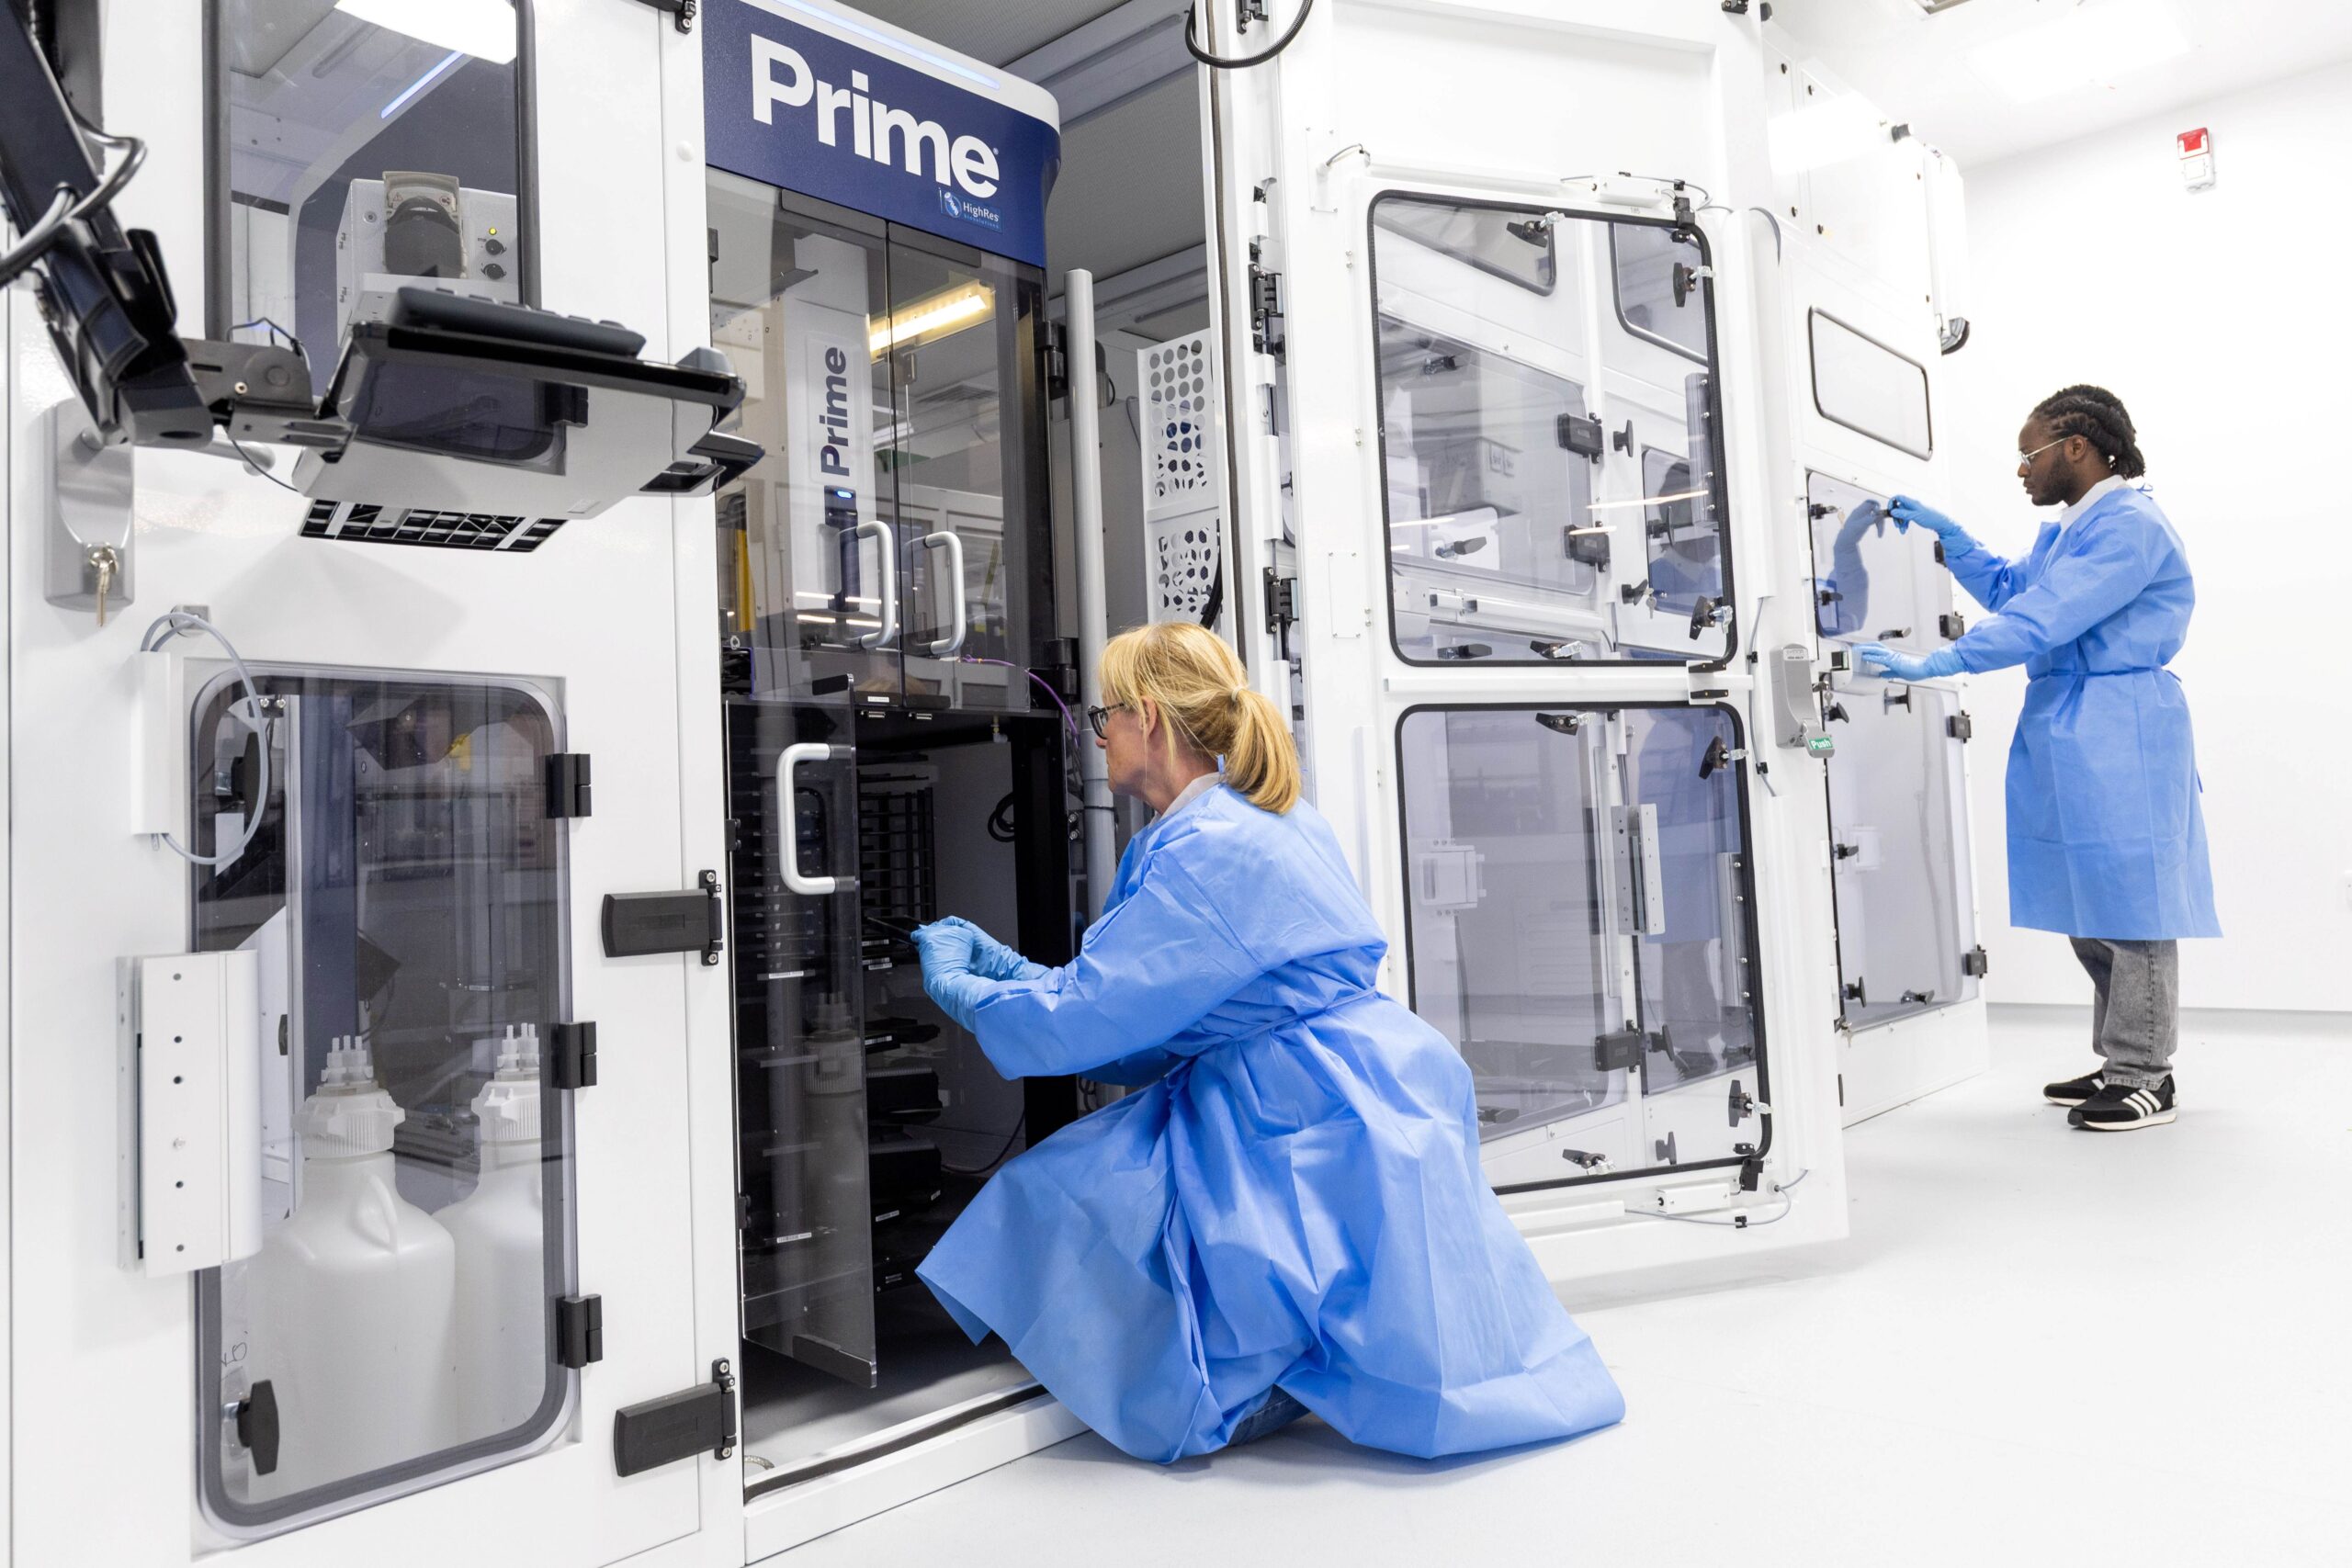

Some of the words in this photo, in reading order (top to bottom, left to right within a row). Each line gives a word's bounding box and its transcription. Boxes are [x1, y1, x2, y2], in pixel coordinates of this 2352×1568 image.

[751, 33, 1000, 198] Prime
[963, 201, 1000, 222] HighRes
[819, 347, 850, 477] Prime
[1810, 739, 1832, 750] Push
